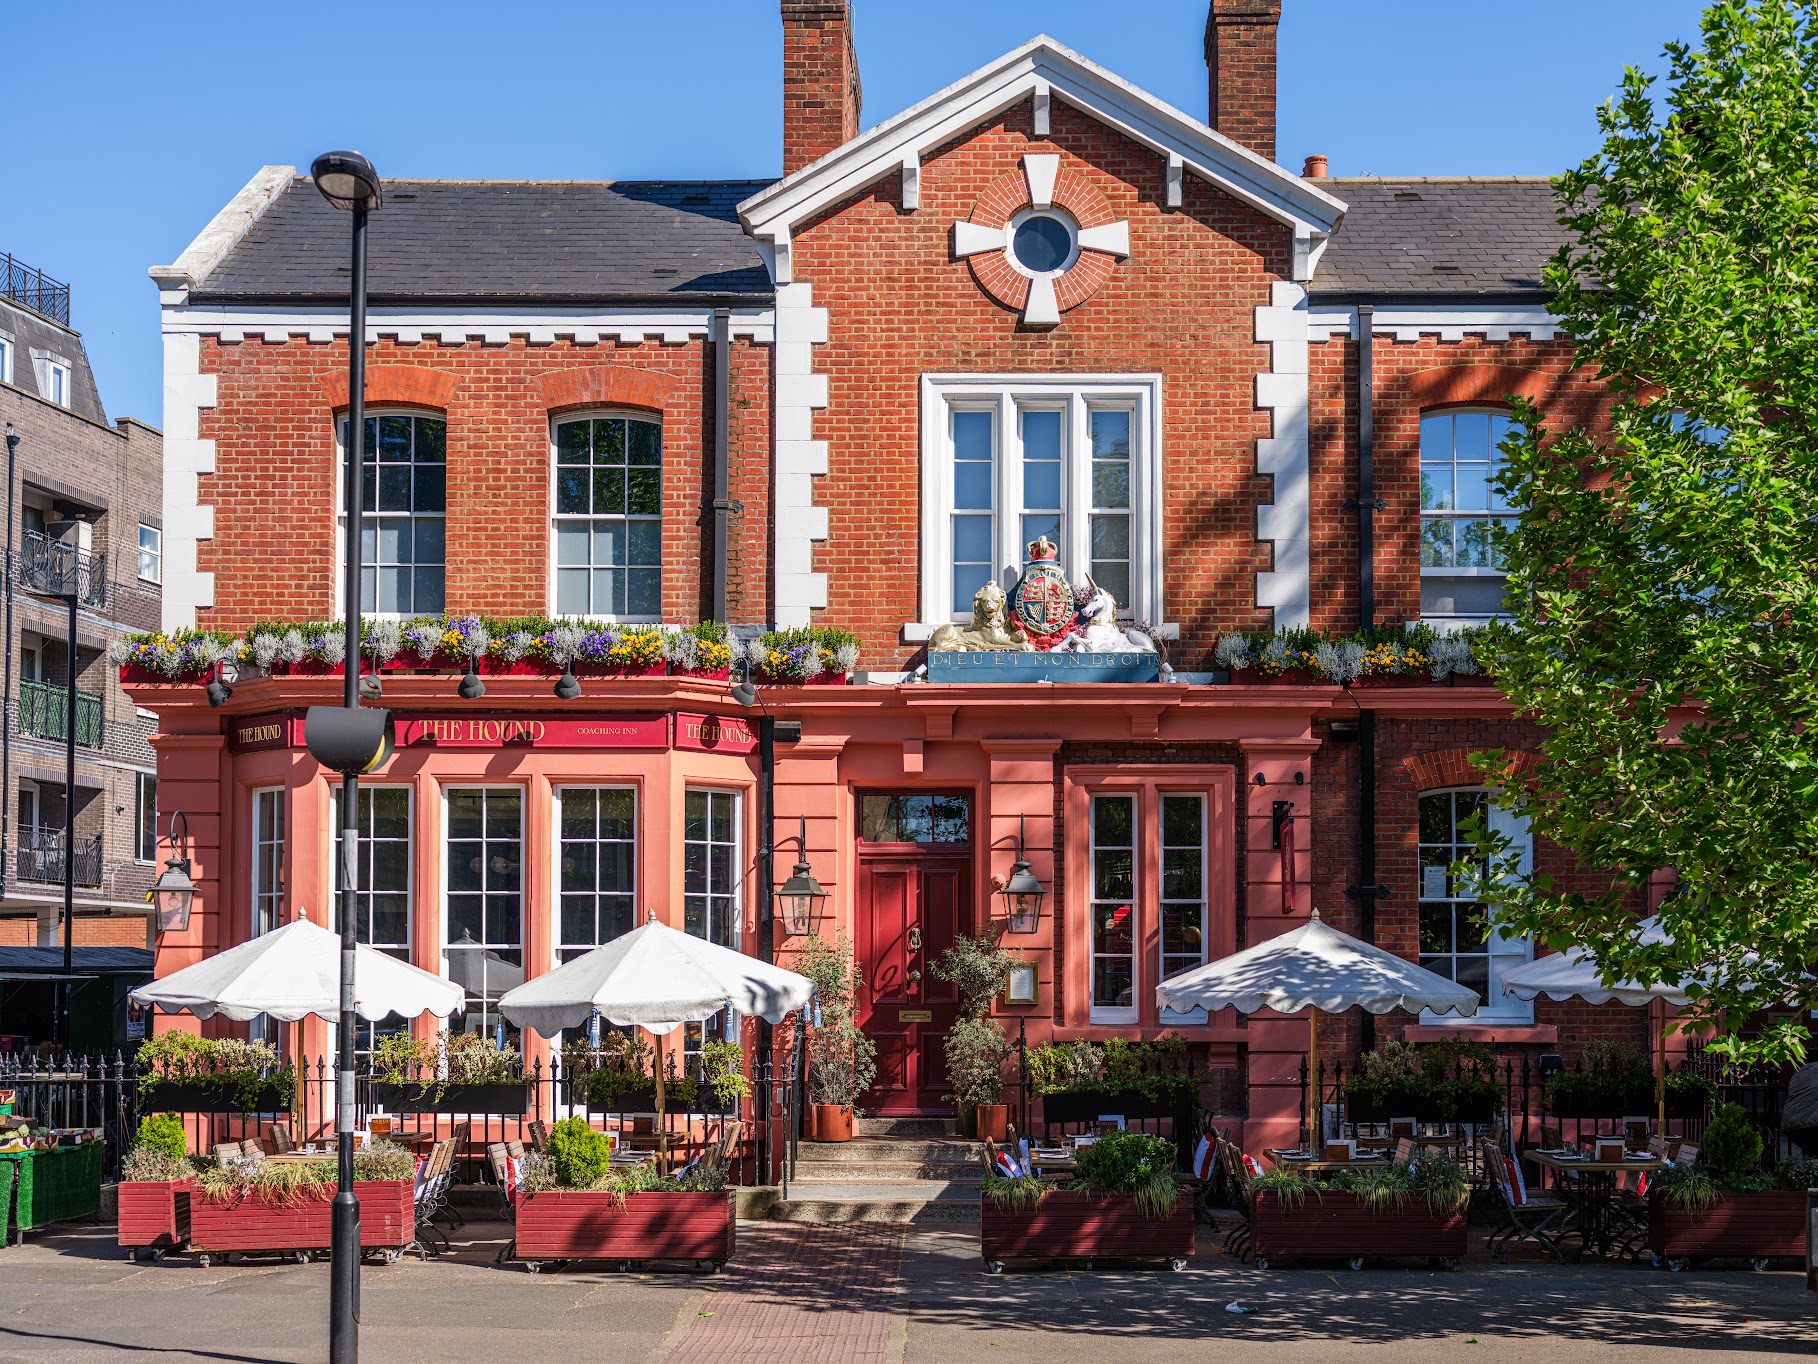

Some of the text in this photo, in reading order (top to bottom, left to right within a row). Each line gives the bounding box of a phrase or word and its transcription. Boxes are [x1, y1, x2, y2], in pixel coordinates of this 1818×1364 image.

[933, 653, 1154, 666] DIEU ET MON DROIT
[238, 724, 281, 743] THE HOUND
[418, 719, 546, 742] THE HOUND
[577, 727, 638, 735] COACHING INN
[685, 723, 752, 744] THE HOUND
